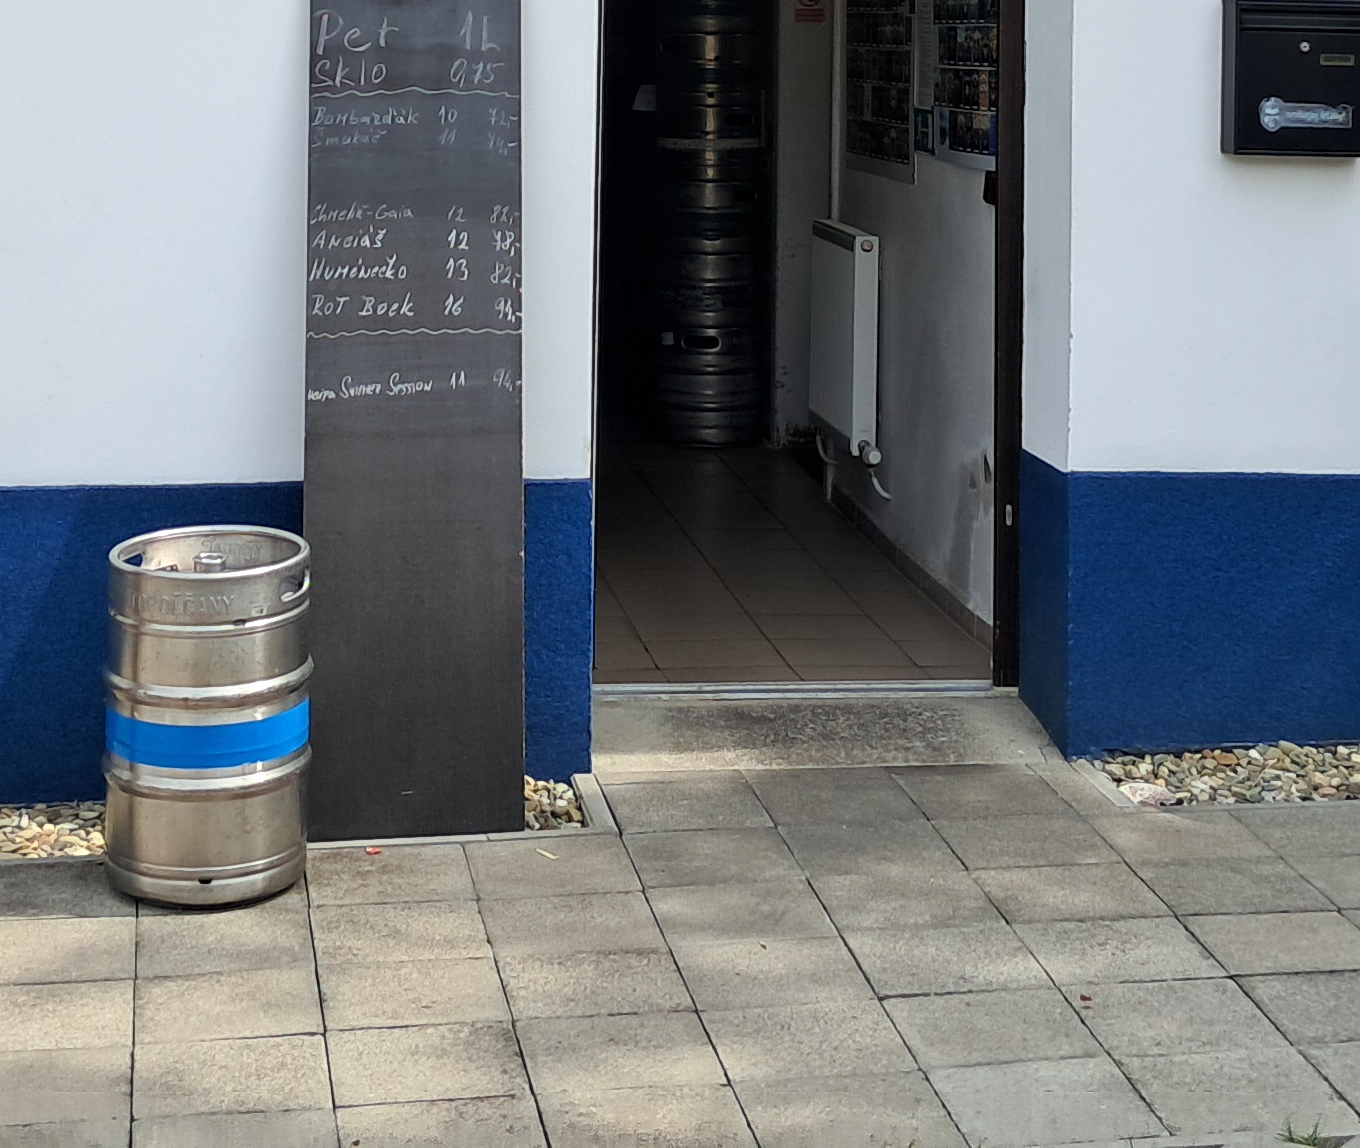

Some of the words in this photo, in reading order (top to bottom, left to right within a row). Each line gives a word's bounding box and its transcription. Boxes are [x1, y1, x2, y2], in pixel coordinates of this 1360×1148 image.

[312, 9, 399, 55] Pet
[438, 105, 458, 123] 10
[438, 128, 458, 145] 11
[447, 205, 467, 223] 12
[447, 229, 470, 251] 12
[445, 257, 470, 282] 13
[443, 293, 465, 317] 16
[448, 370, 466, 391] 11
